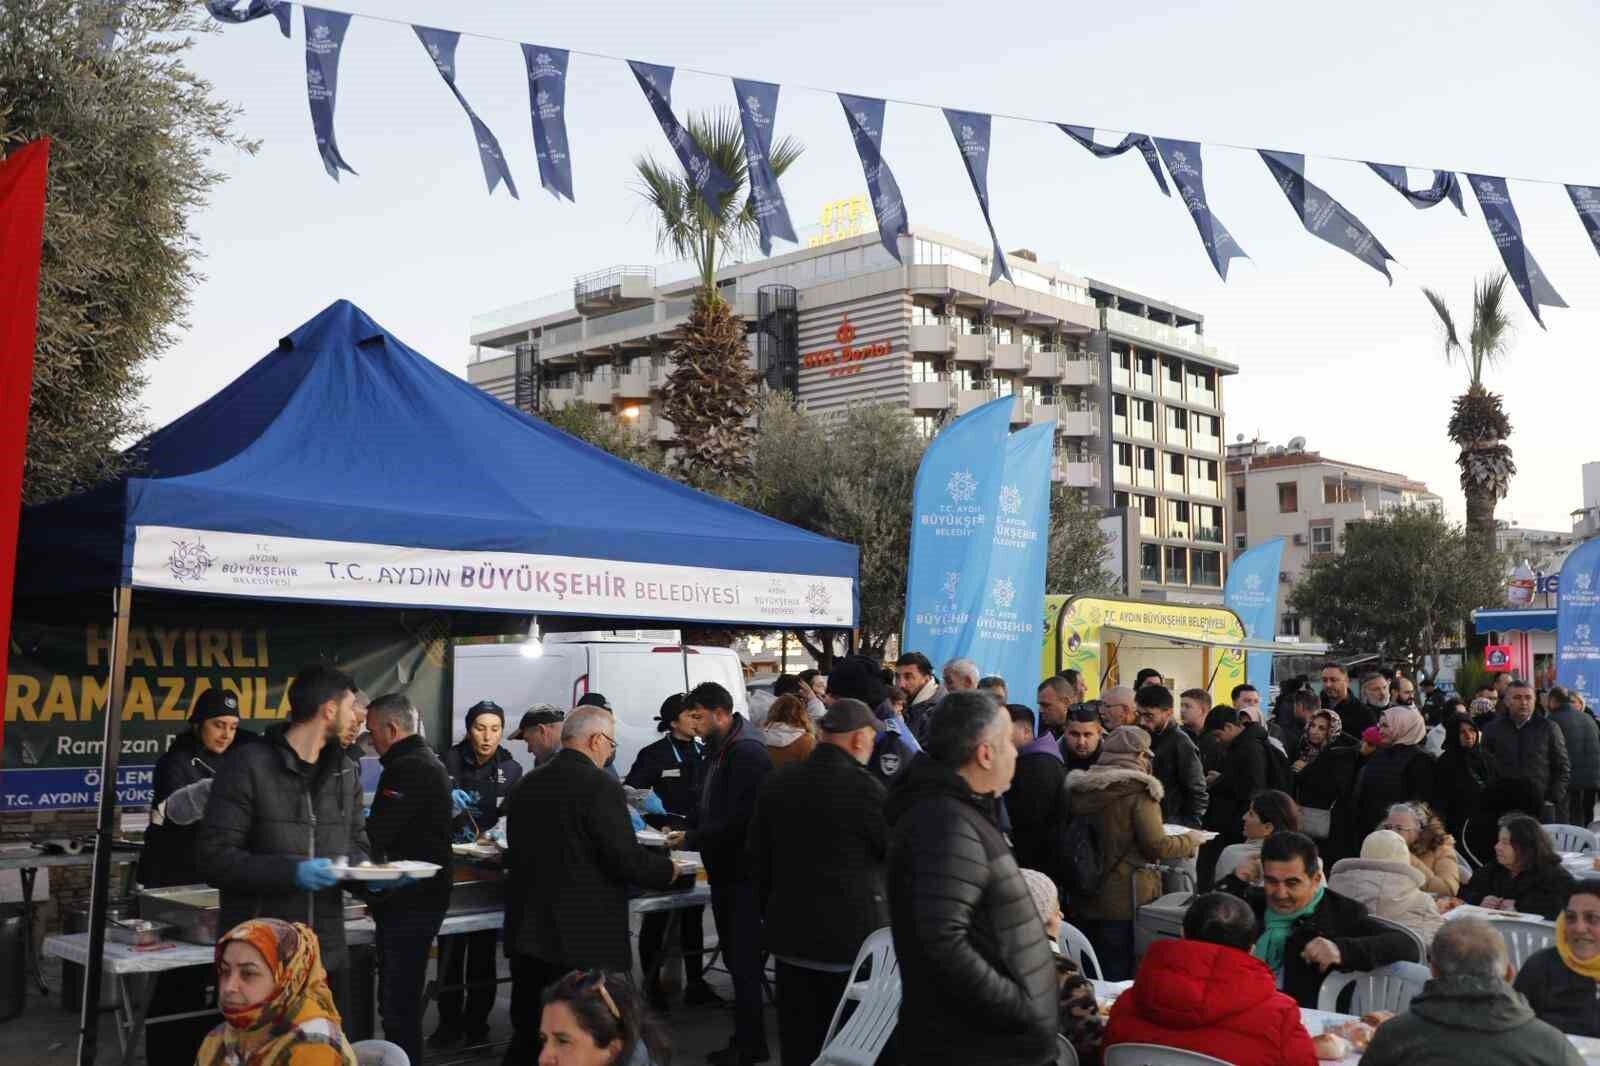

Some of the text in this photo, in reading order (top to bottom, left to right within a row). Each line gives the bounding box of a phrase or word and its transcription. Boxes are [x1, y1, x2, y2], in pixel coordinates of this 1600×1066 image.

[248, 554, 279, 563] AYDIN
[222, 562, 298, 577] BÜYÜKŞEHİR
[232, 577, 290, 587] BELEDİYESİ
[325, 561, 741, 605] T.C. AYDIN BÜYÜKŞEHİR BELEDİYESİ
[85, 627, 270, 668] HAYIRLI
[57, 736, 158, 755] Ramzan
[84, 770, 153, 786] ÖLEM
[5, 794, 33, 806] T.C.
[38, 792, 89, 805] AYDIN
